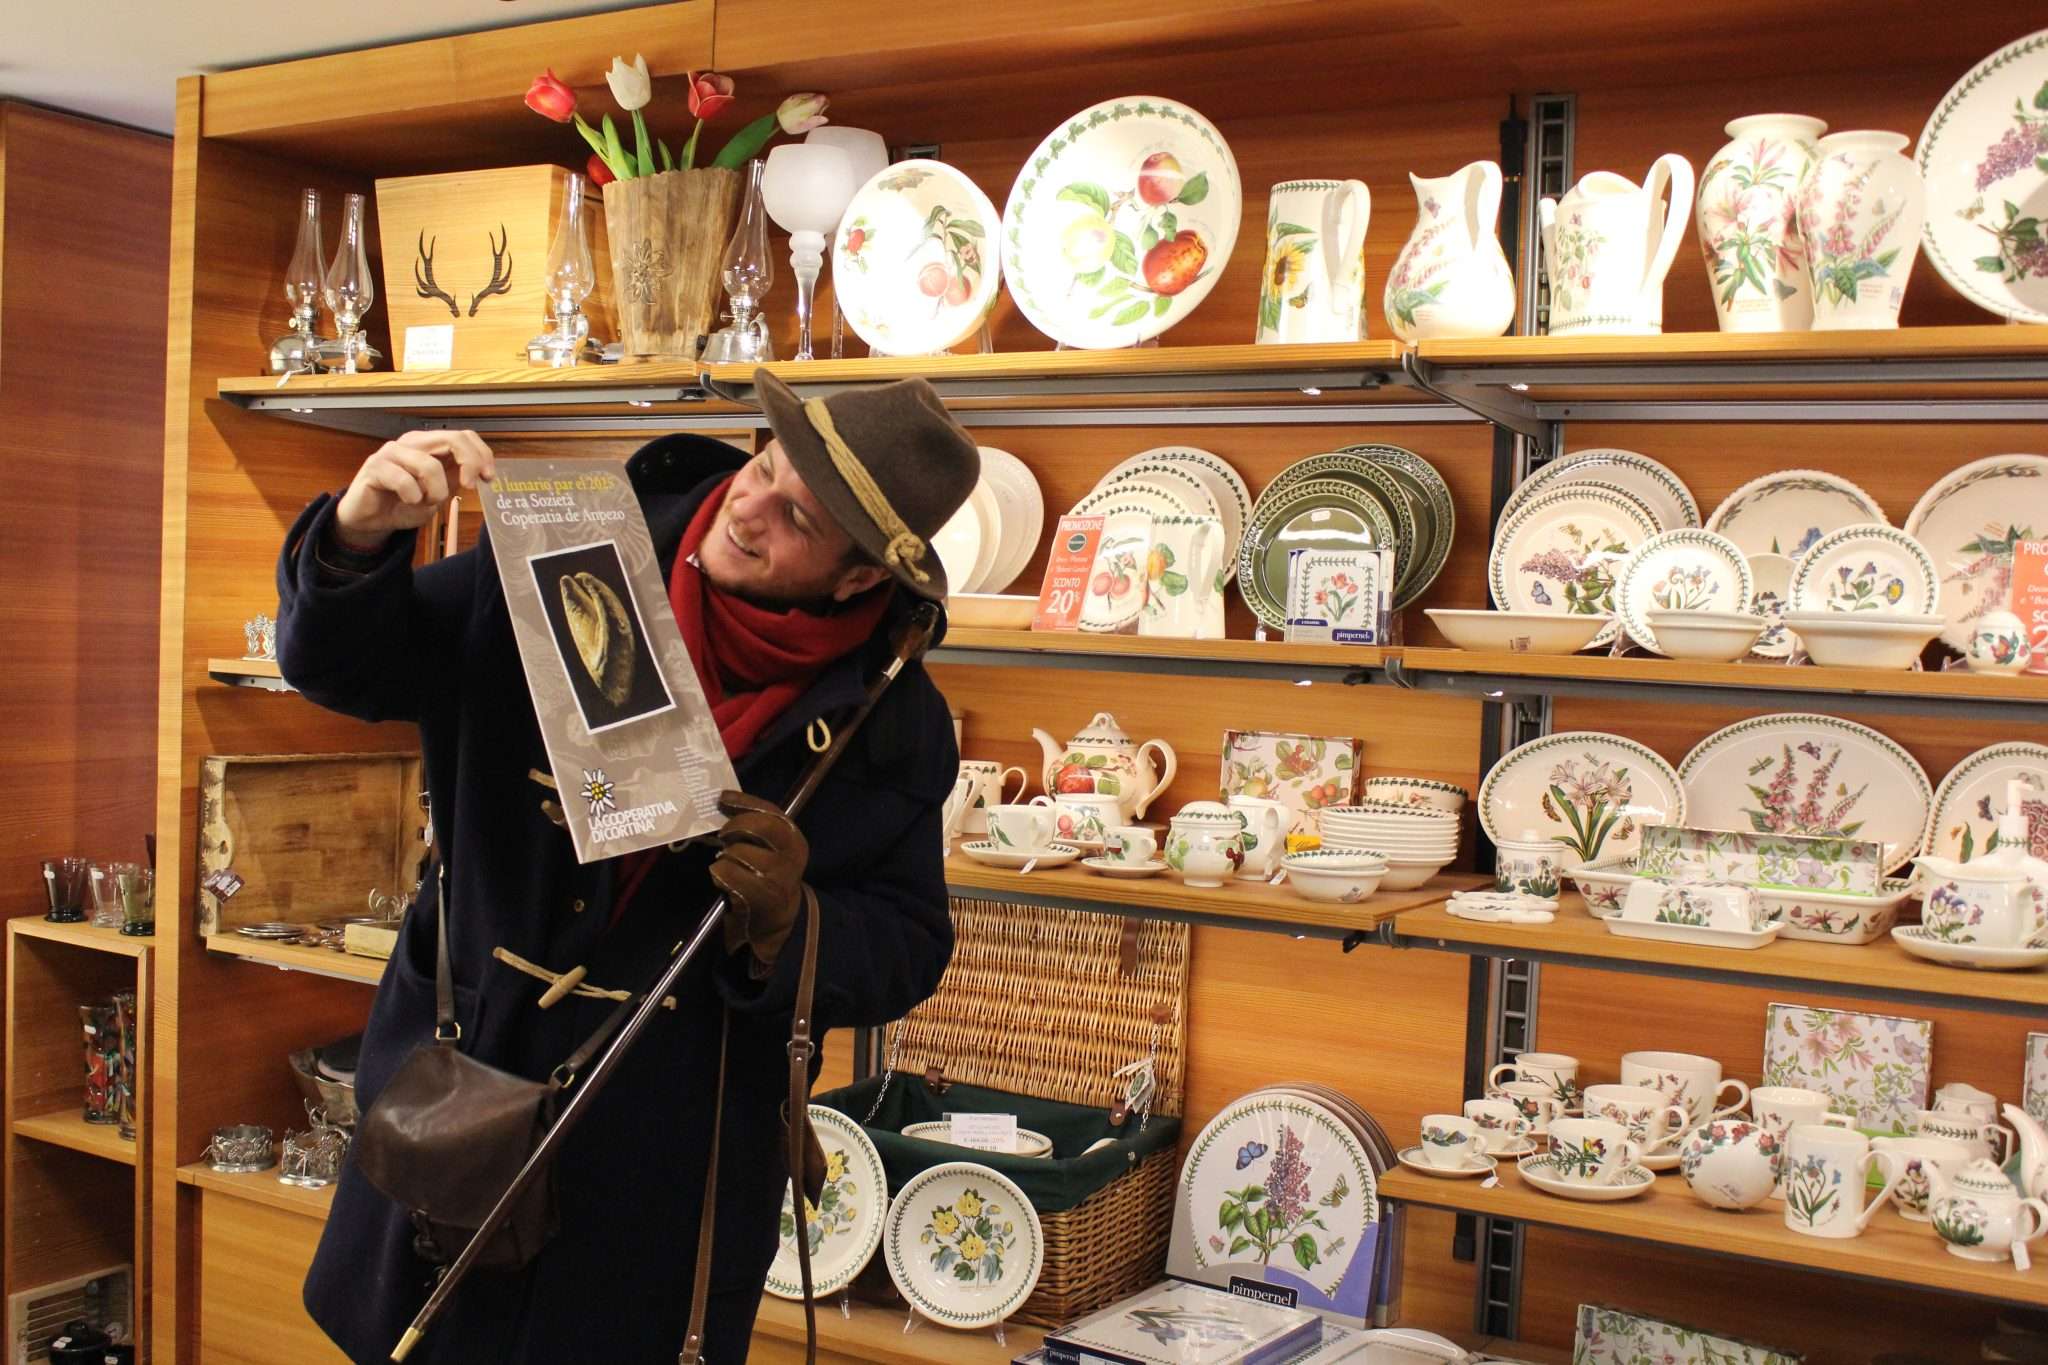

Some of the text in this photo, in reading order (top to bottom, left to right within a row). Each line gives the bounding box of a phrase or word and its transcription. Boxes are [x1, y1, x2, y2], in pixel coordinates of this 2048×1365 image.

[497, 494, 512, 509] de
[515, 498, 529, 508] ra
[501, 509, 562, 528] Coperatia
[565, 508, 579, 522] de
[1053, 577, 1081, 588] SCONTO
[1336, 631, 1369, 641] pimpernel
[588, 816, 603, 831] LA
[602, 800, 678, 828] COOPERATIVA
[604, 819, 656, 840] CORTINA
[1231, 1282, 1292, 1306] pimpernel
